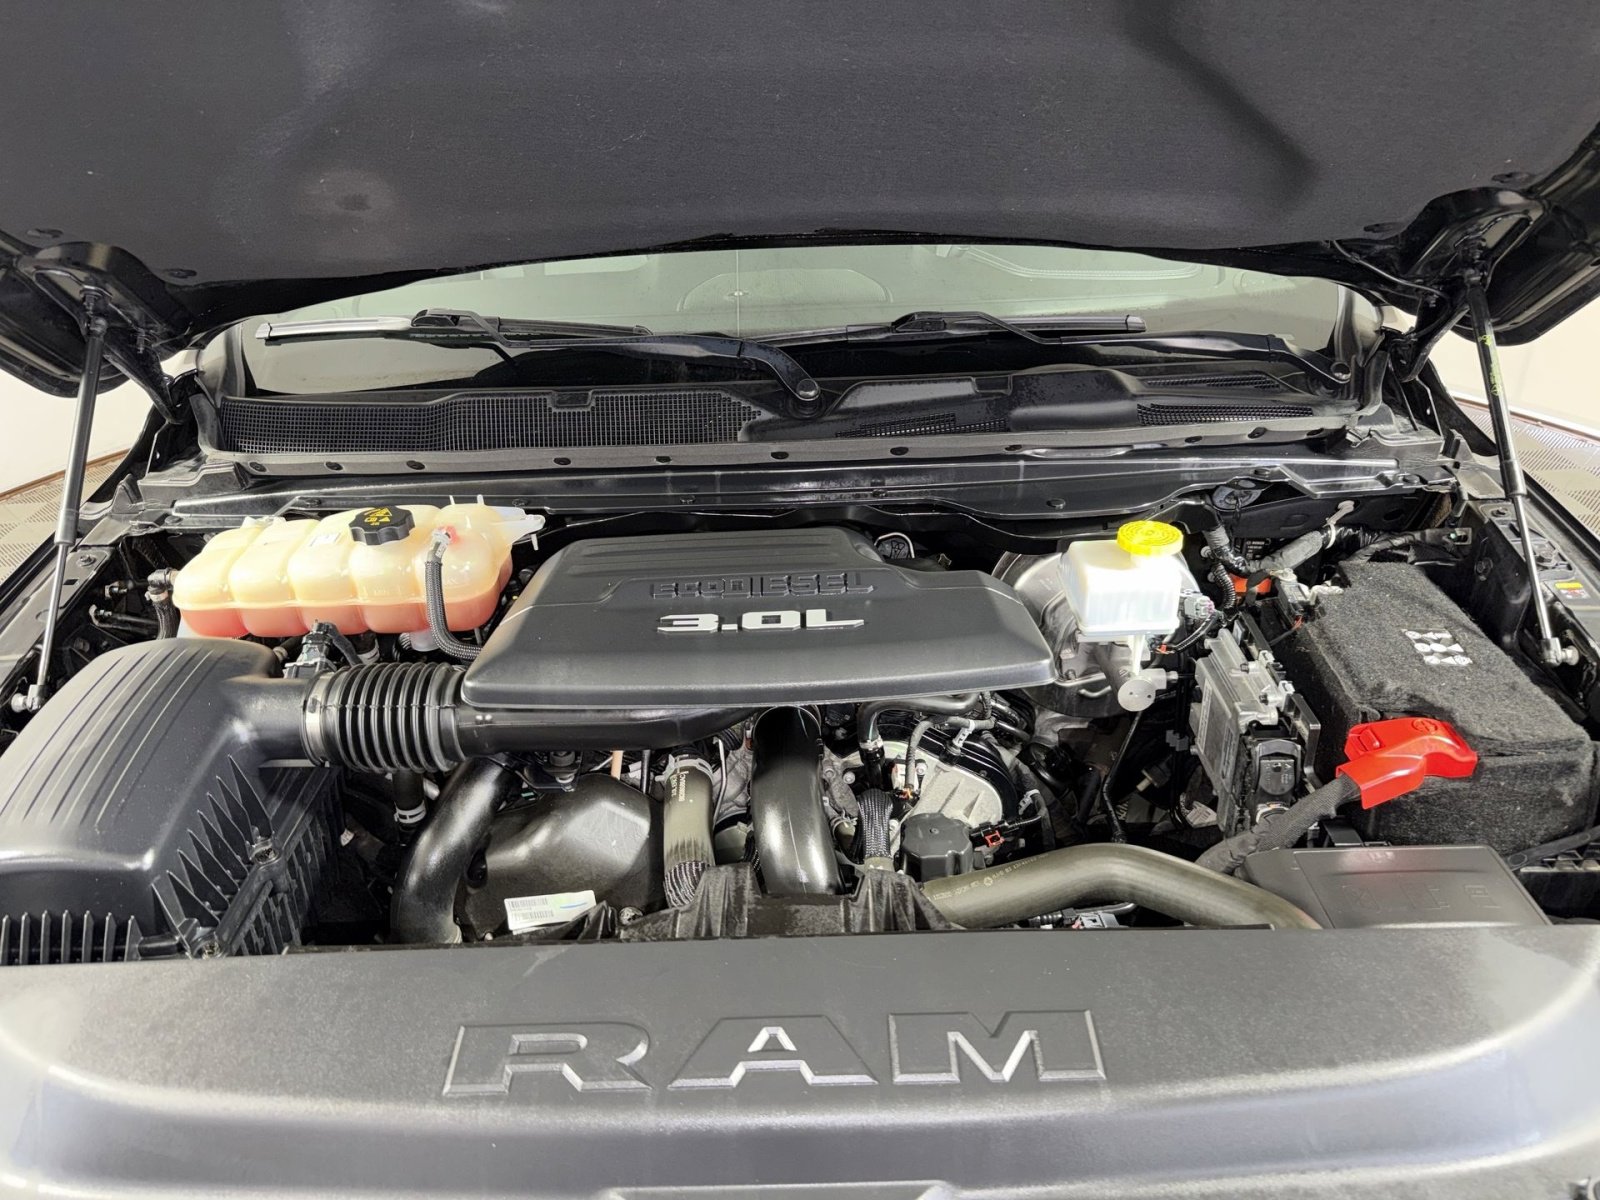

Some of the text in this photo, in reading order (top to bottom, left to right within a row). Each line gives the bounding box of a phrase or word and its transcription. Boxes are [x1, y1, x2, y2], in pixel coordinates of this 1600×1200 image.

[650, 572, 874, 599] ECODIESEL
[657, 609, 864, 633] 3.0L
[443, 1010, 1106, 1095] RAM
